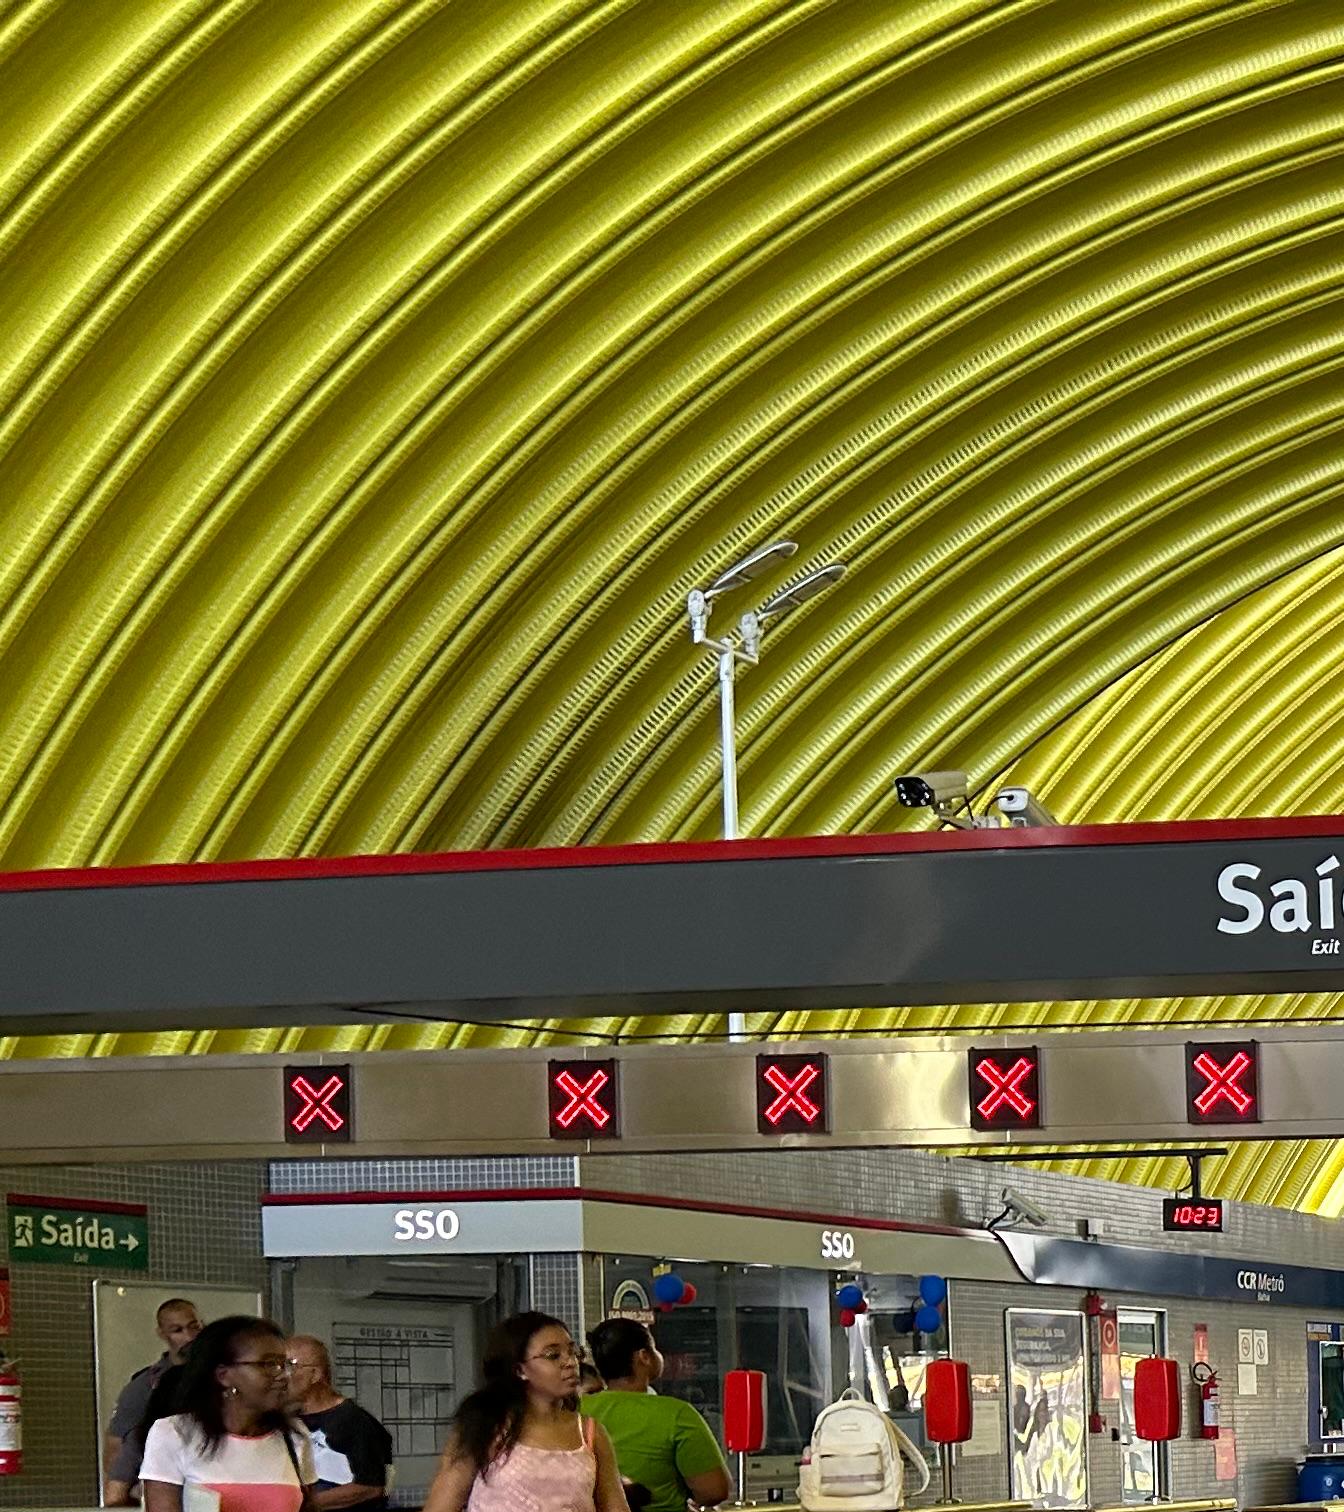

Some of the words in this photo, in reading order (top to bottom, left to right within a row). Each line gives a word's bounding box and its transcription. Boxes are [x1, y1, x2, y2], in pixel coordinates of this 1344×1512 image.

[1311, 939, 1341, 955] Exit
[394, 1209, 460, 1240] SSO
[1173, 1206, 1219, 1225] 10:23
[41, 1214, 115, 1249] Saída
[821, 1230, 855, 1259] SSO
[1237, 1270, 1257, 1290] CCR
[1257, 1273, 1285, 1292] Metrô
